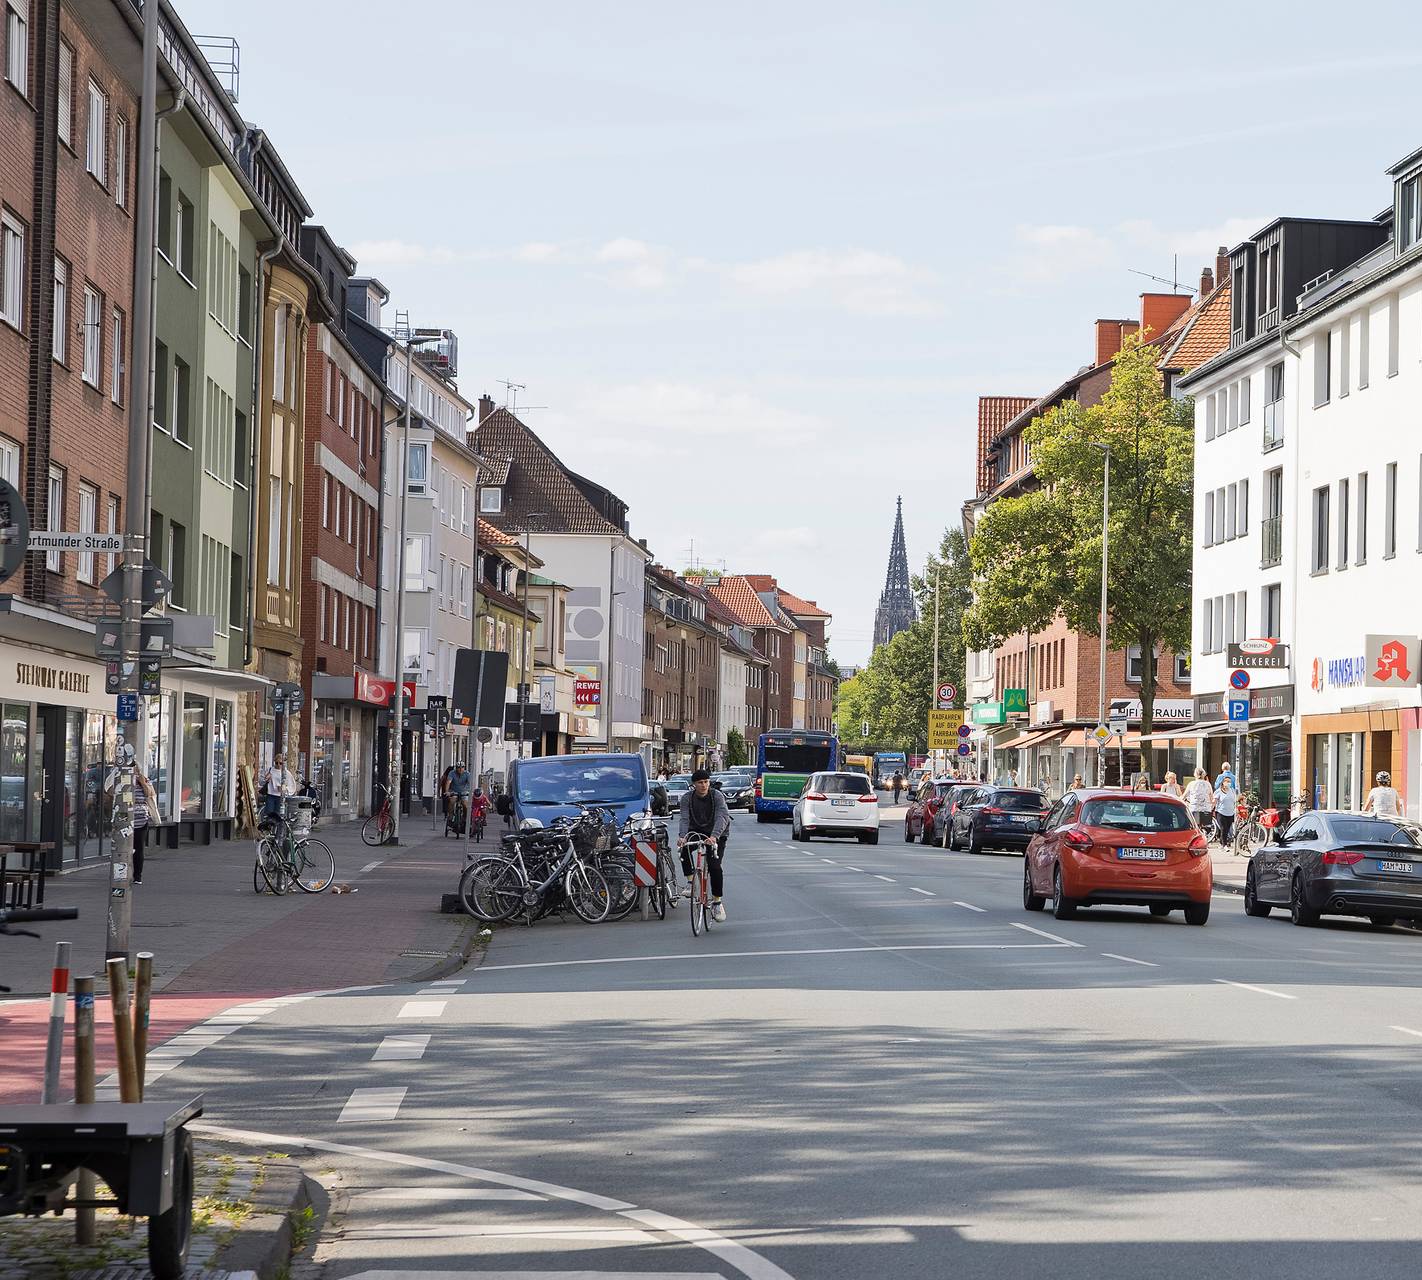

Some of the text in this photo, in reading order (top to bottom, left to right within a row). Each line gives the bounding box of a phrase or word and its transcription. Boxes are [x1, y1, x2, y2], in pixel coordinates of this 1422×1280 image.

[27, 536, 120, 549] ortmunder Straße
[1232, 655, 1280, 666] BÄCKEREI
[16, 662, 90, 694] STEINWAY GALERIE
[577, 682, 600, 690] REWE
[941, 688, 952, 697] 30
[429, 700, 443, 709] BAR
[1125, 708, 1138, 718] IFI
[1233, 702, 1245, 719] P
[1150, 849, 1165, 859] 138
